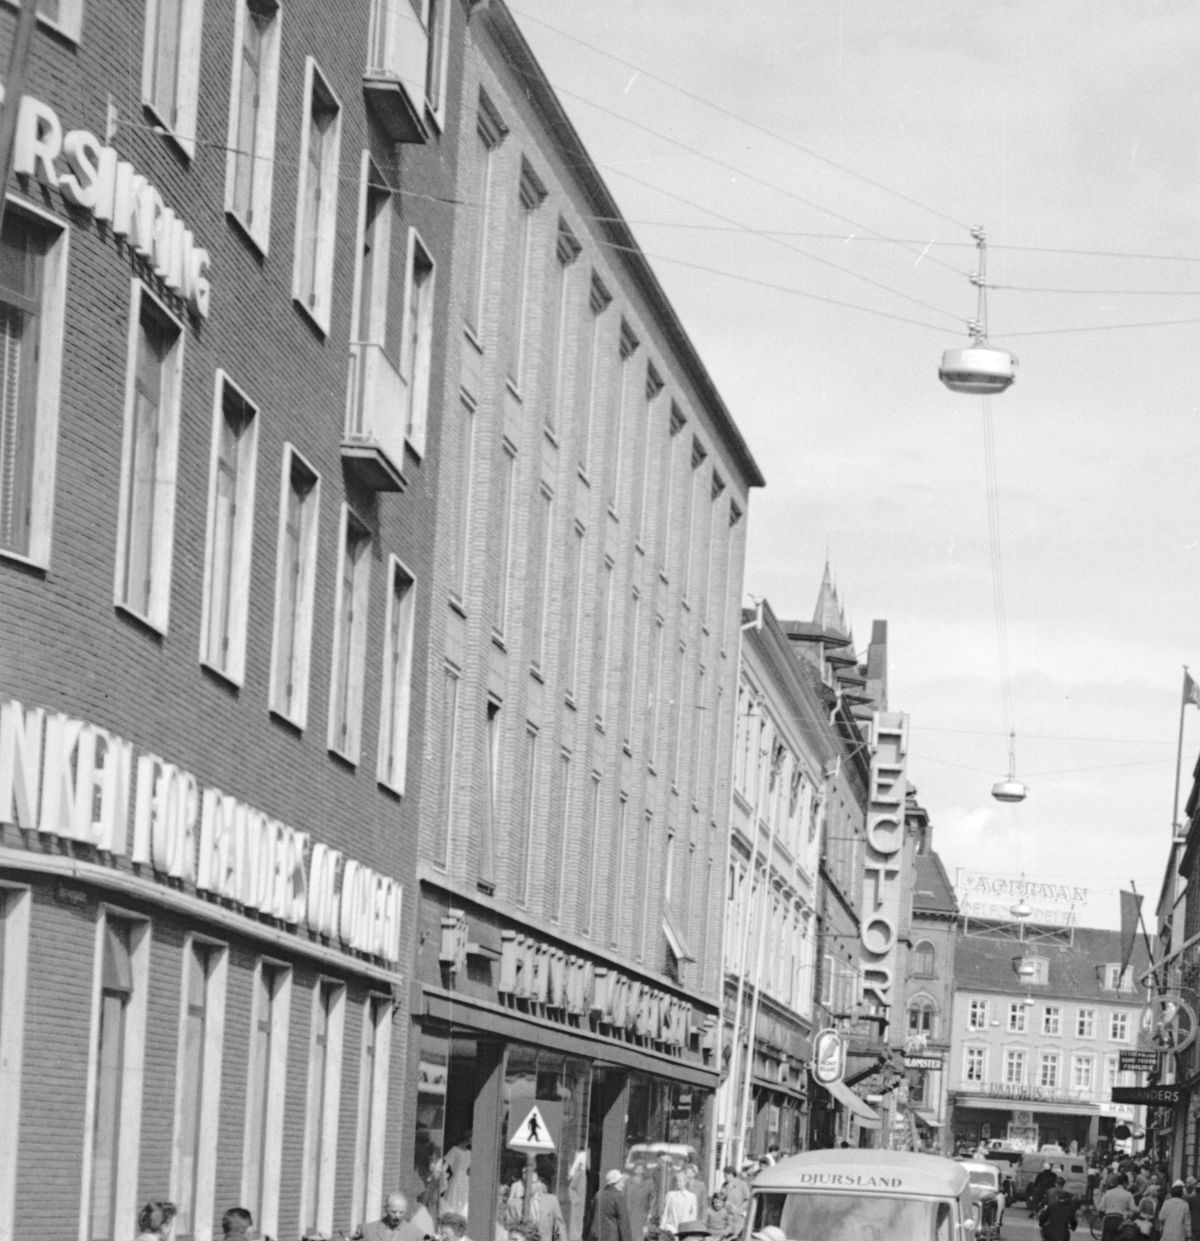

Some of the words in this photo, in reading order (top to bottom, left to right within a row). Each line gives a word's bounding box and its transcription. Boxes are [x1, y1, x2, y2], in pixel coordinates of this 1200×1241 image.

[12, 94, 212, 320] RSIKRING
[132, 752, 200, 883] FOR
[197, 787, 310, 925] RANDERS
[308, 842, 343, 940] OG
[859, 711, 908, 1006] HECTOR
[799, 1172, 903, 1188] DJURSLAND
[1129, 1089, 1180, 1103] RANDERS
